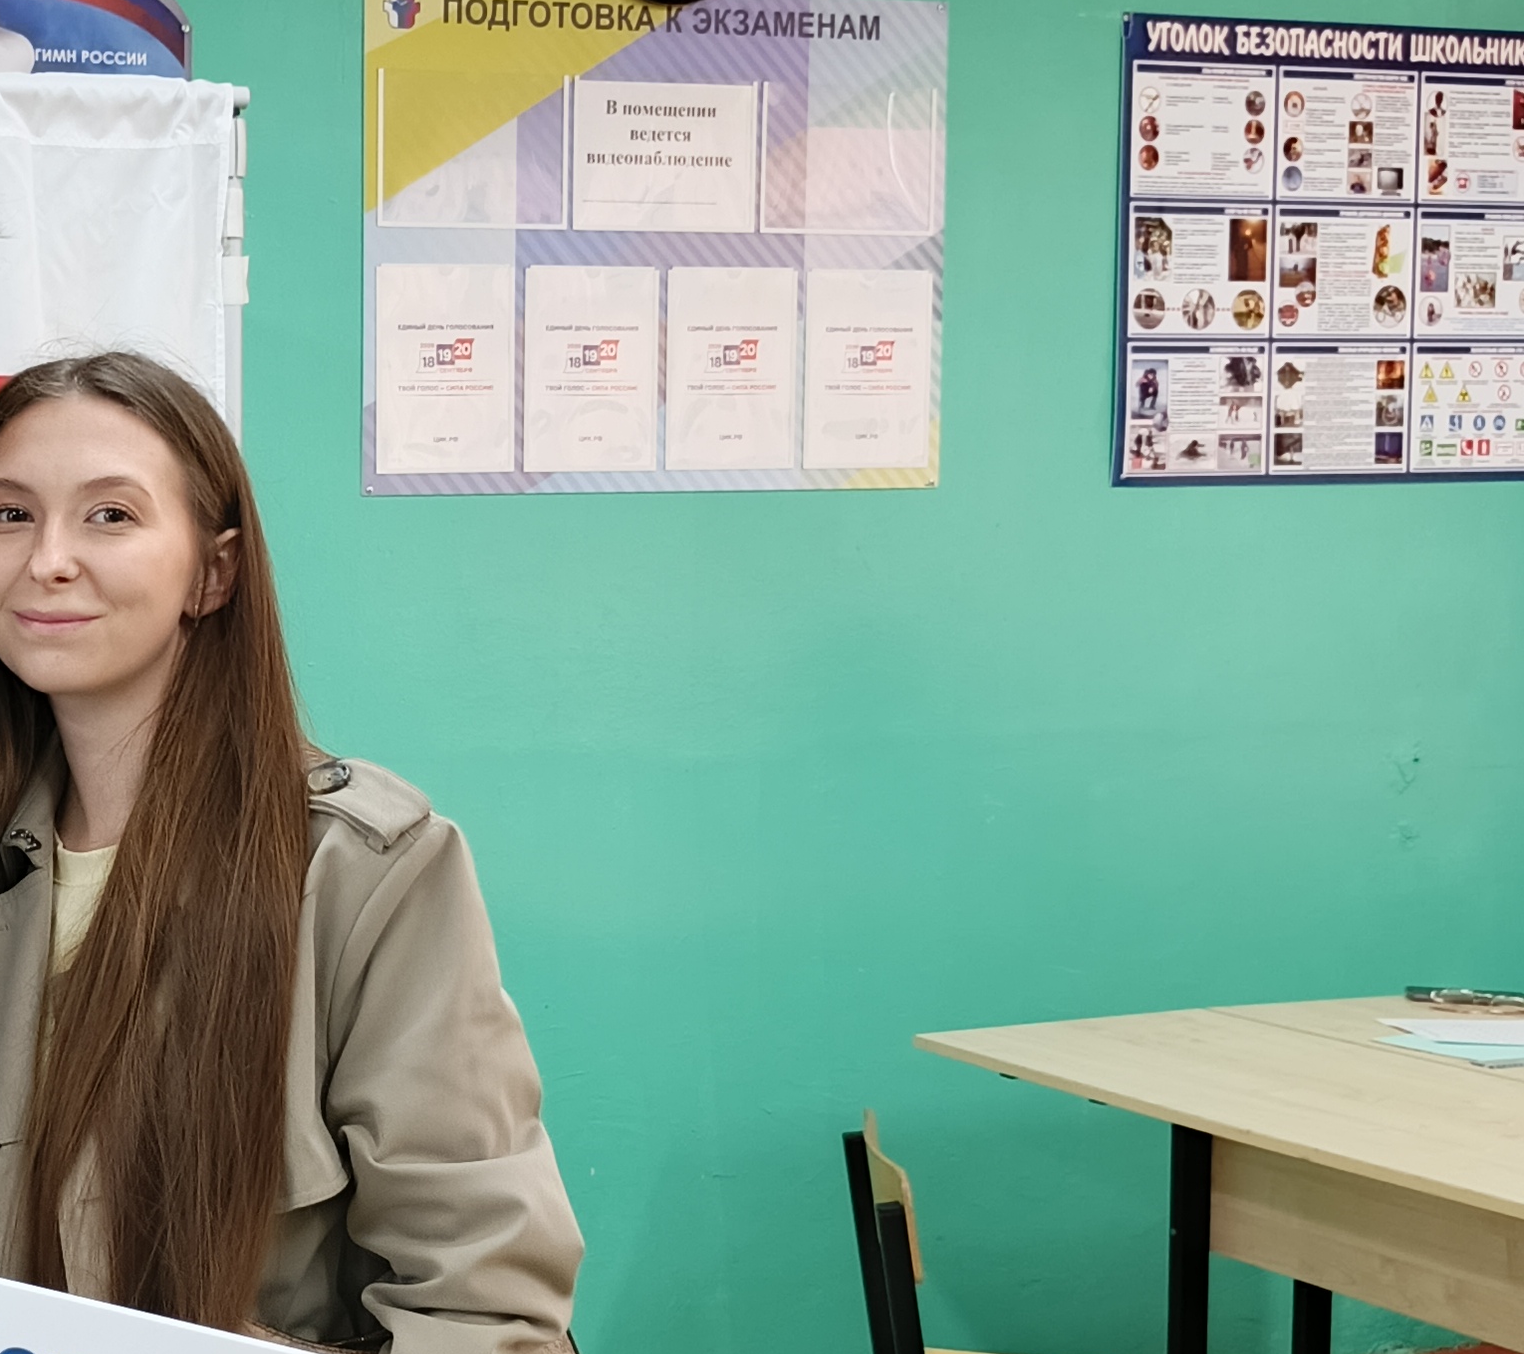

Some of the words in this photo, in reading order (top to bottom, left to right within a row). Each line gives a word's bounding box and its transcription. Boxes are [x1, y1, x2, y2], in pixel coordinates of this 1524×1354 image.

[665, 6, 684, 34] К
[692, 6, 882, 42] ЭКЗАМЕНАМ
[1146, 19, 1230, 56] УГОЛОК
[1235, 24, 1403, 61] БЕЗОПАСНОСТИ
[35, 48, 77, 63] ГИМН
[81, 49, 147, 66] РОССИИ
[605, 99, 618, 115] В
[622, 104, 717, 119] помещении
[629, 129, 692, 143] ведется
[586, 150, 734, 168] видеонаблюдение
[422, 356, 436, 368] 18
[438, 348, 453, 362] 19
[454, 342, 472, 356] 20
[568, 356, 582, 368] 18
[584, 349, 598, 362] 19
[599, 344, 616, 357] 20
[709, 356, 722, 368] 18
[724, 349, 738, 362] 19
[739, 343, 757, 356] 20
[847, 357, 859, 368] 18
[861, 350, 875, 362] 19
[876, 345, 892, 357] 20
